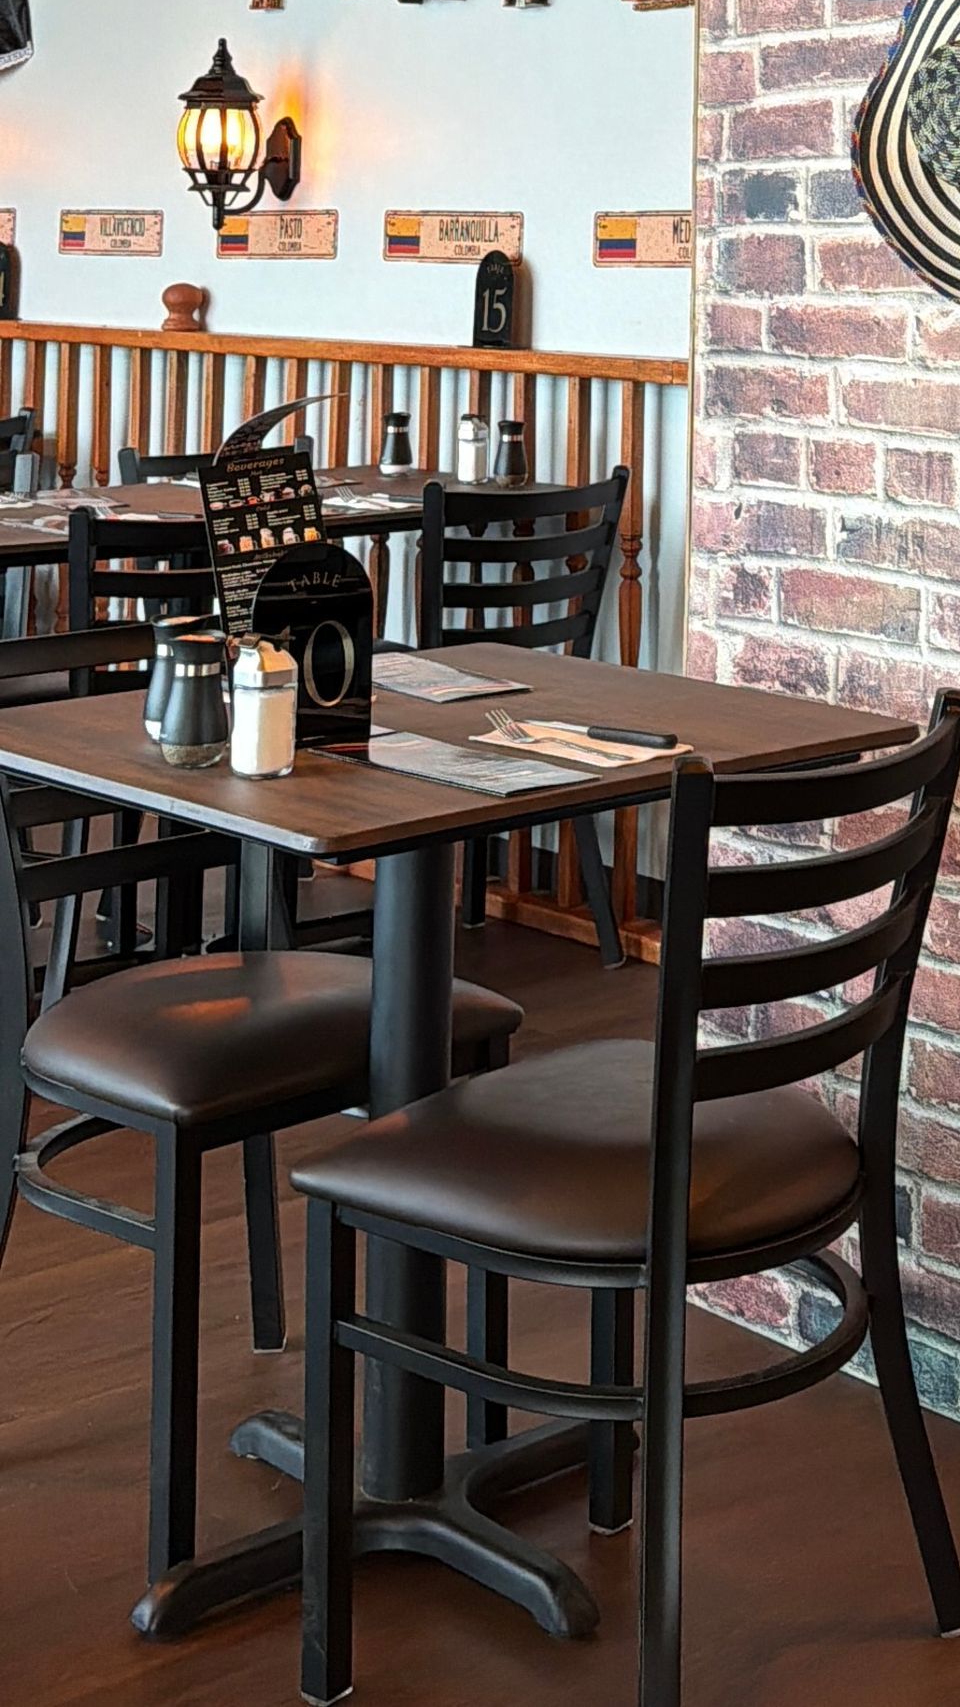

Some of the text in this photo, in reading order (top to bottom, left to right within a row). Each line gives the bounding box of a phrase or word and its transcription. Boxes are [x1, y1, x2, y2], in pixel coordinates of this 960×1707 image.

[279, 216, 302, 239] PASTO
[439, 219, 499, 243] BARRANQUILLA
[454, 244, 480, 256] COLOMBIA
[481, 287, 507, 333] 15
[226, 458, 284, 472] Beverages
[288, 571, 341, 592] TABLE
